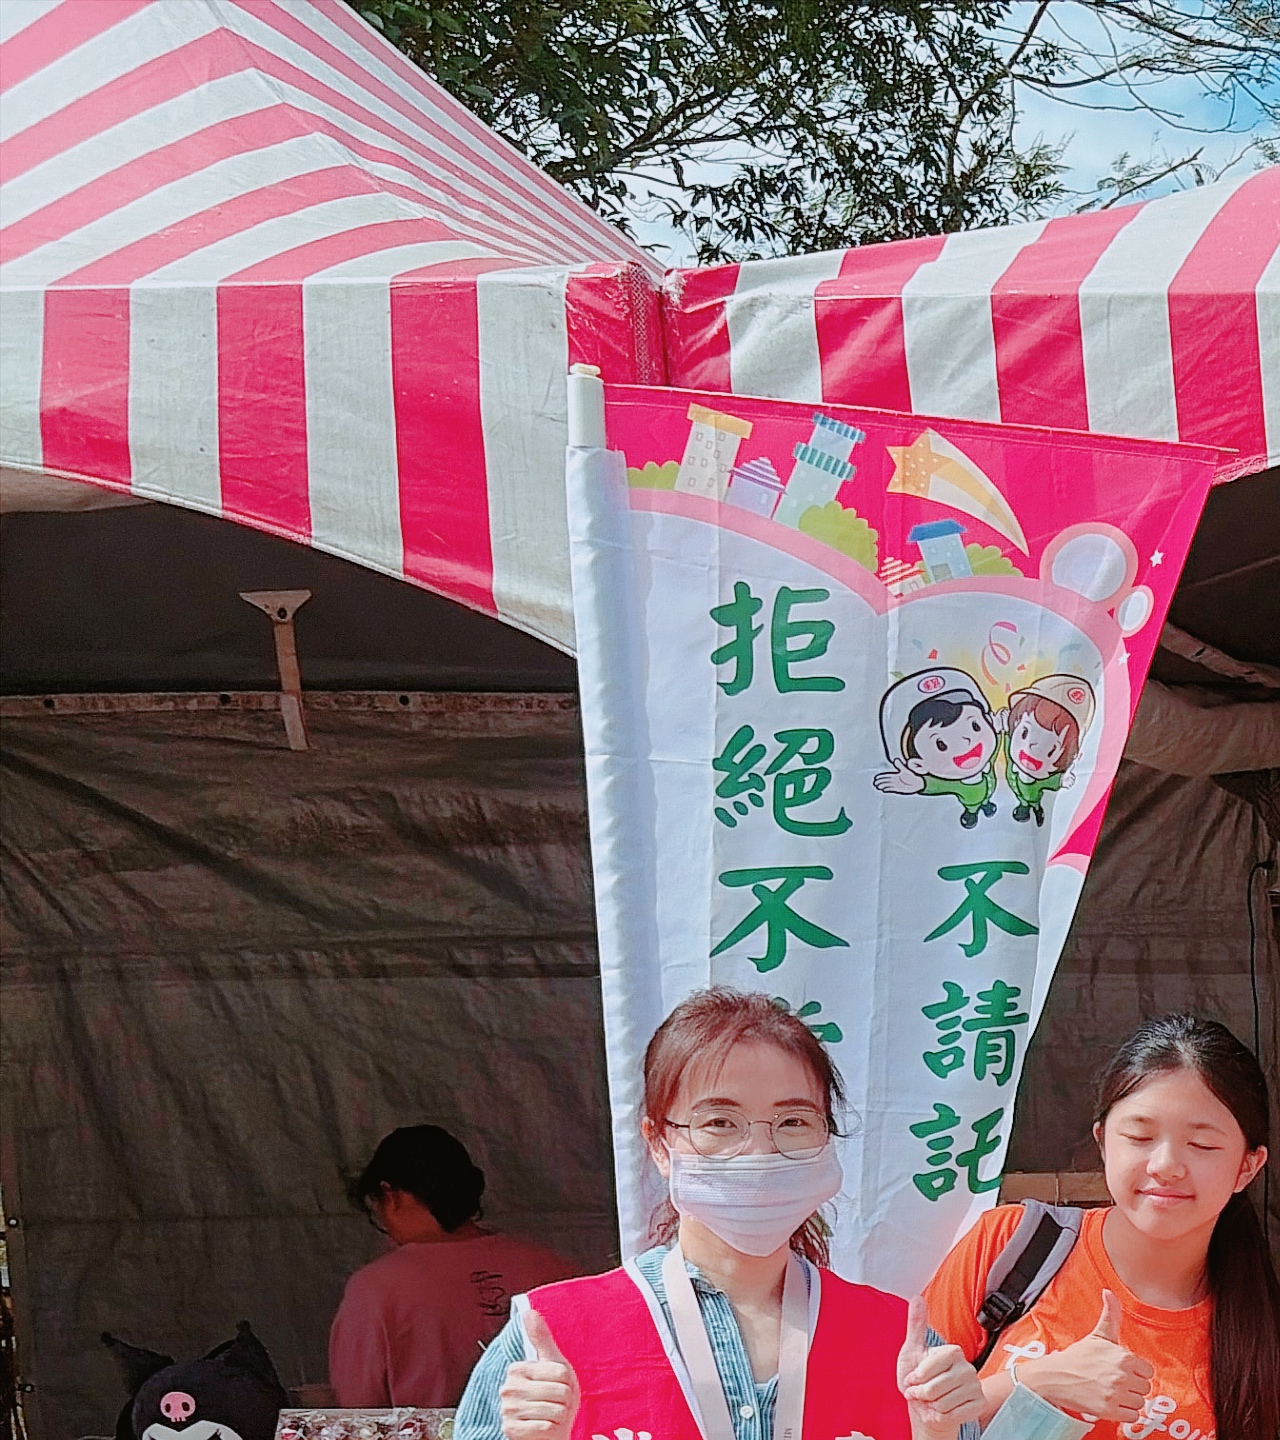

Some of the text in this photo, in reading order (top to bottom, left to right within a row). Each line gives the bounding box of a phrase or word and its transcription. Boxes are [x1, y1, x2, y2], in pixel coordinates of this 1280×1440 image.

[709, 580, 852, 1044] 拒絕不
[909, 860, 1040, 1202] 不請託
